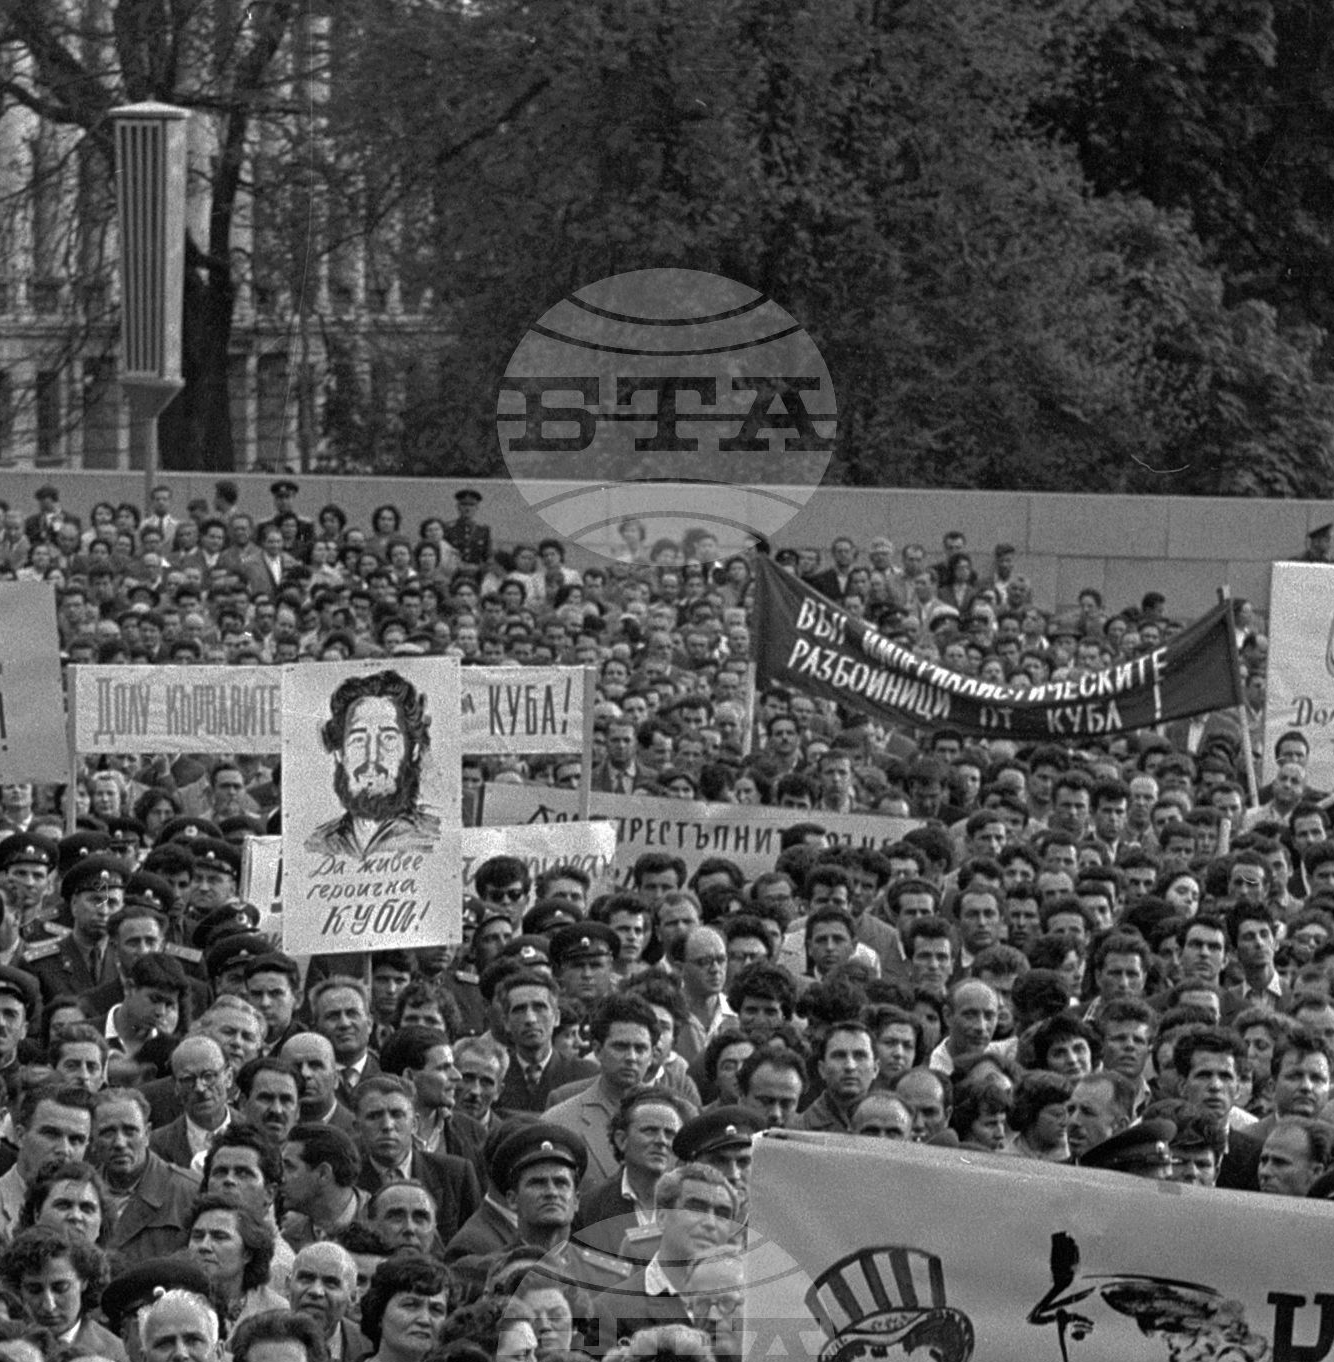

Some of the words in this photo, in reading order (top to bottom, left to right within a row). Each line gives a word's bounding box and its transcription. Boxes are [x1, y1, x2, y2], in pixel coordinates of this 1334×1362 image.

[488, 677, 572, 736] КУБА!
[615, 817, 784, 854] ПРЕСТЪПНИ
[308, 854, 346, 878] Да
[357, 852, 424, 874] живее
[306, 878, 418, 901] героична
